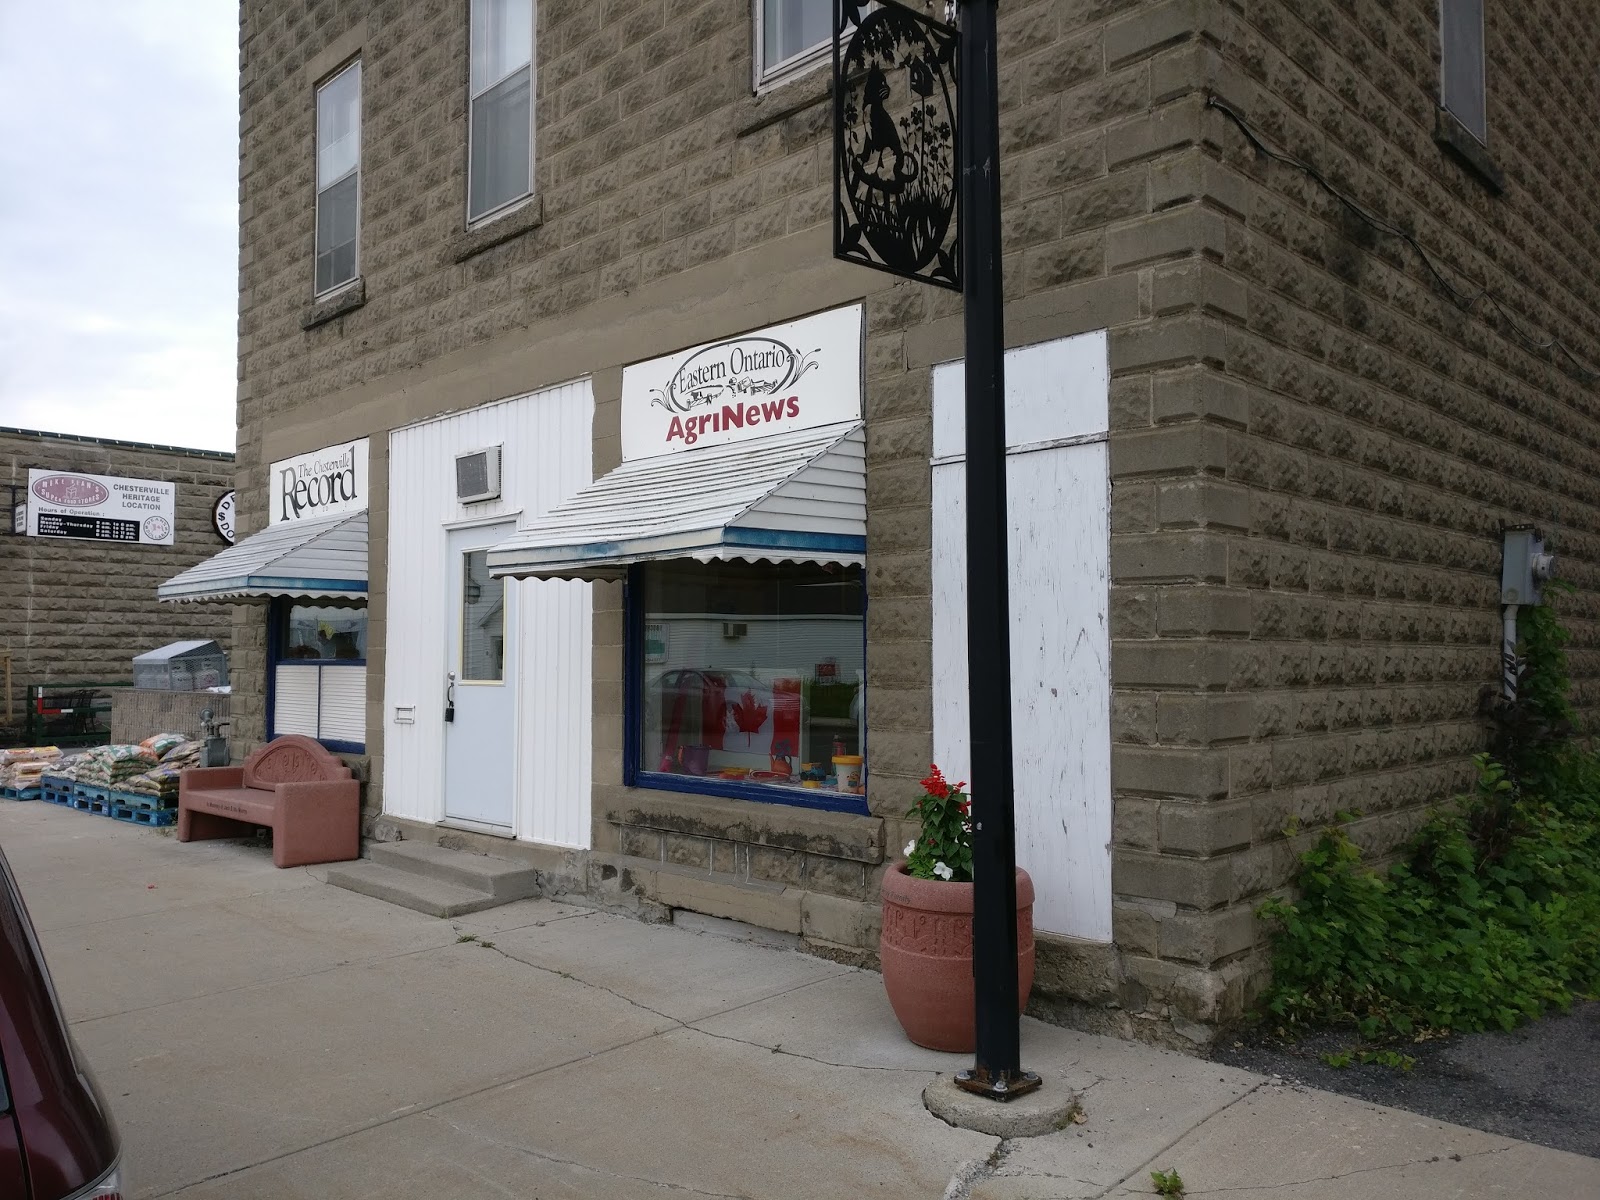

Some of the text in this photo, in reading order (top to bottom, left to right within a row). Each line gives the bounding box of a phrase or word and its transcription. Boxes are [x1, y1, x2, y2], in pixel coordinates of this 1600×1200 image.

[678, 344, 785, 394] Eastern Ontario
[665, 395, 801, 445] AgriNews
[298, 452, 350, 478] The Chesterville
[113, 483, 170, 495] CHESTERVILLE
[279, 444, 358, 522] Record
[41, 488, 62, 502] SUPER
[78, 493, 100, 504] STORES
[122, 493, 161, 503] HERITAGE
[69, 509, 100, 517] Operation
[122, 501, 161, 511] LOCATION
